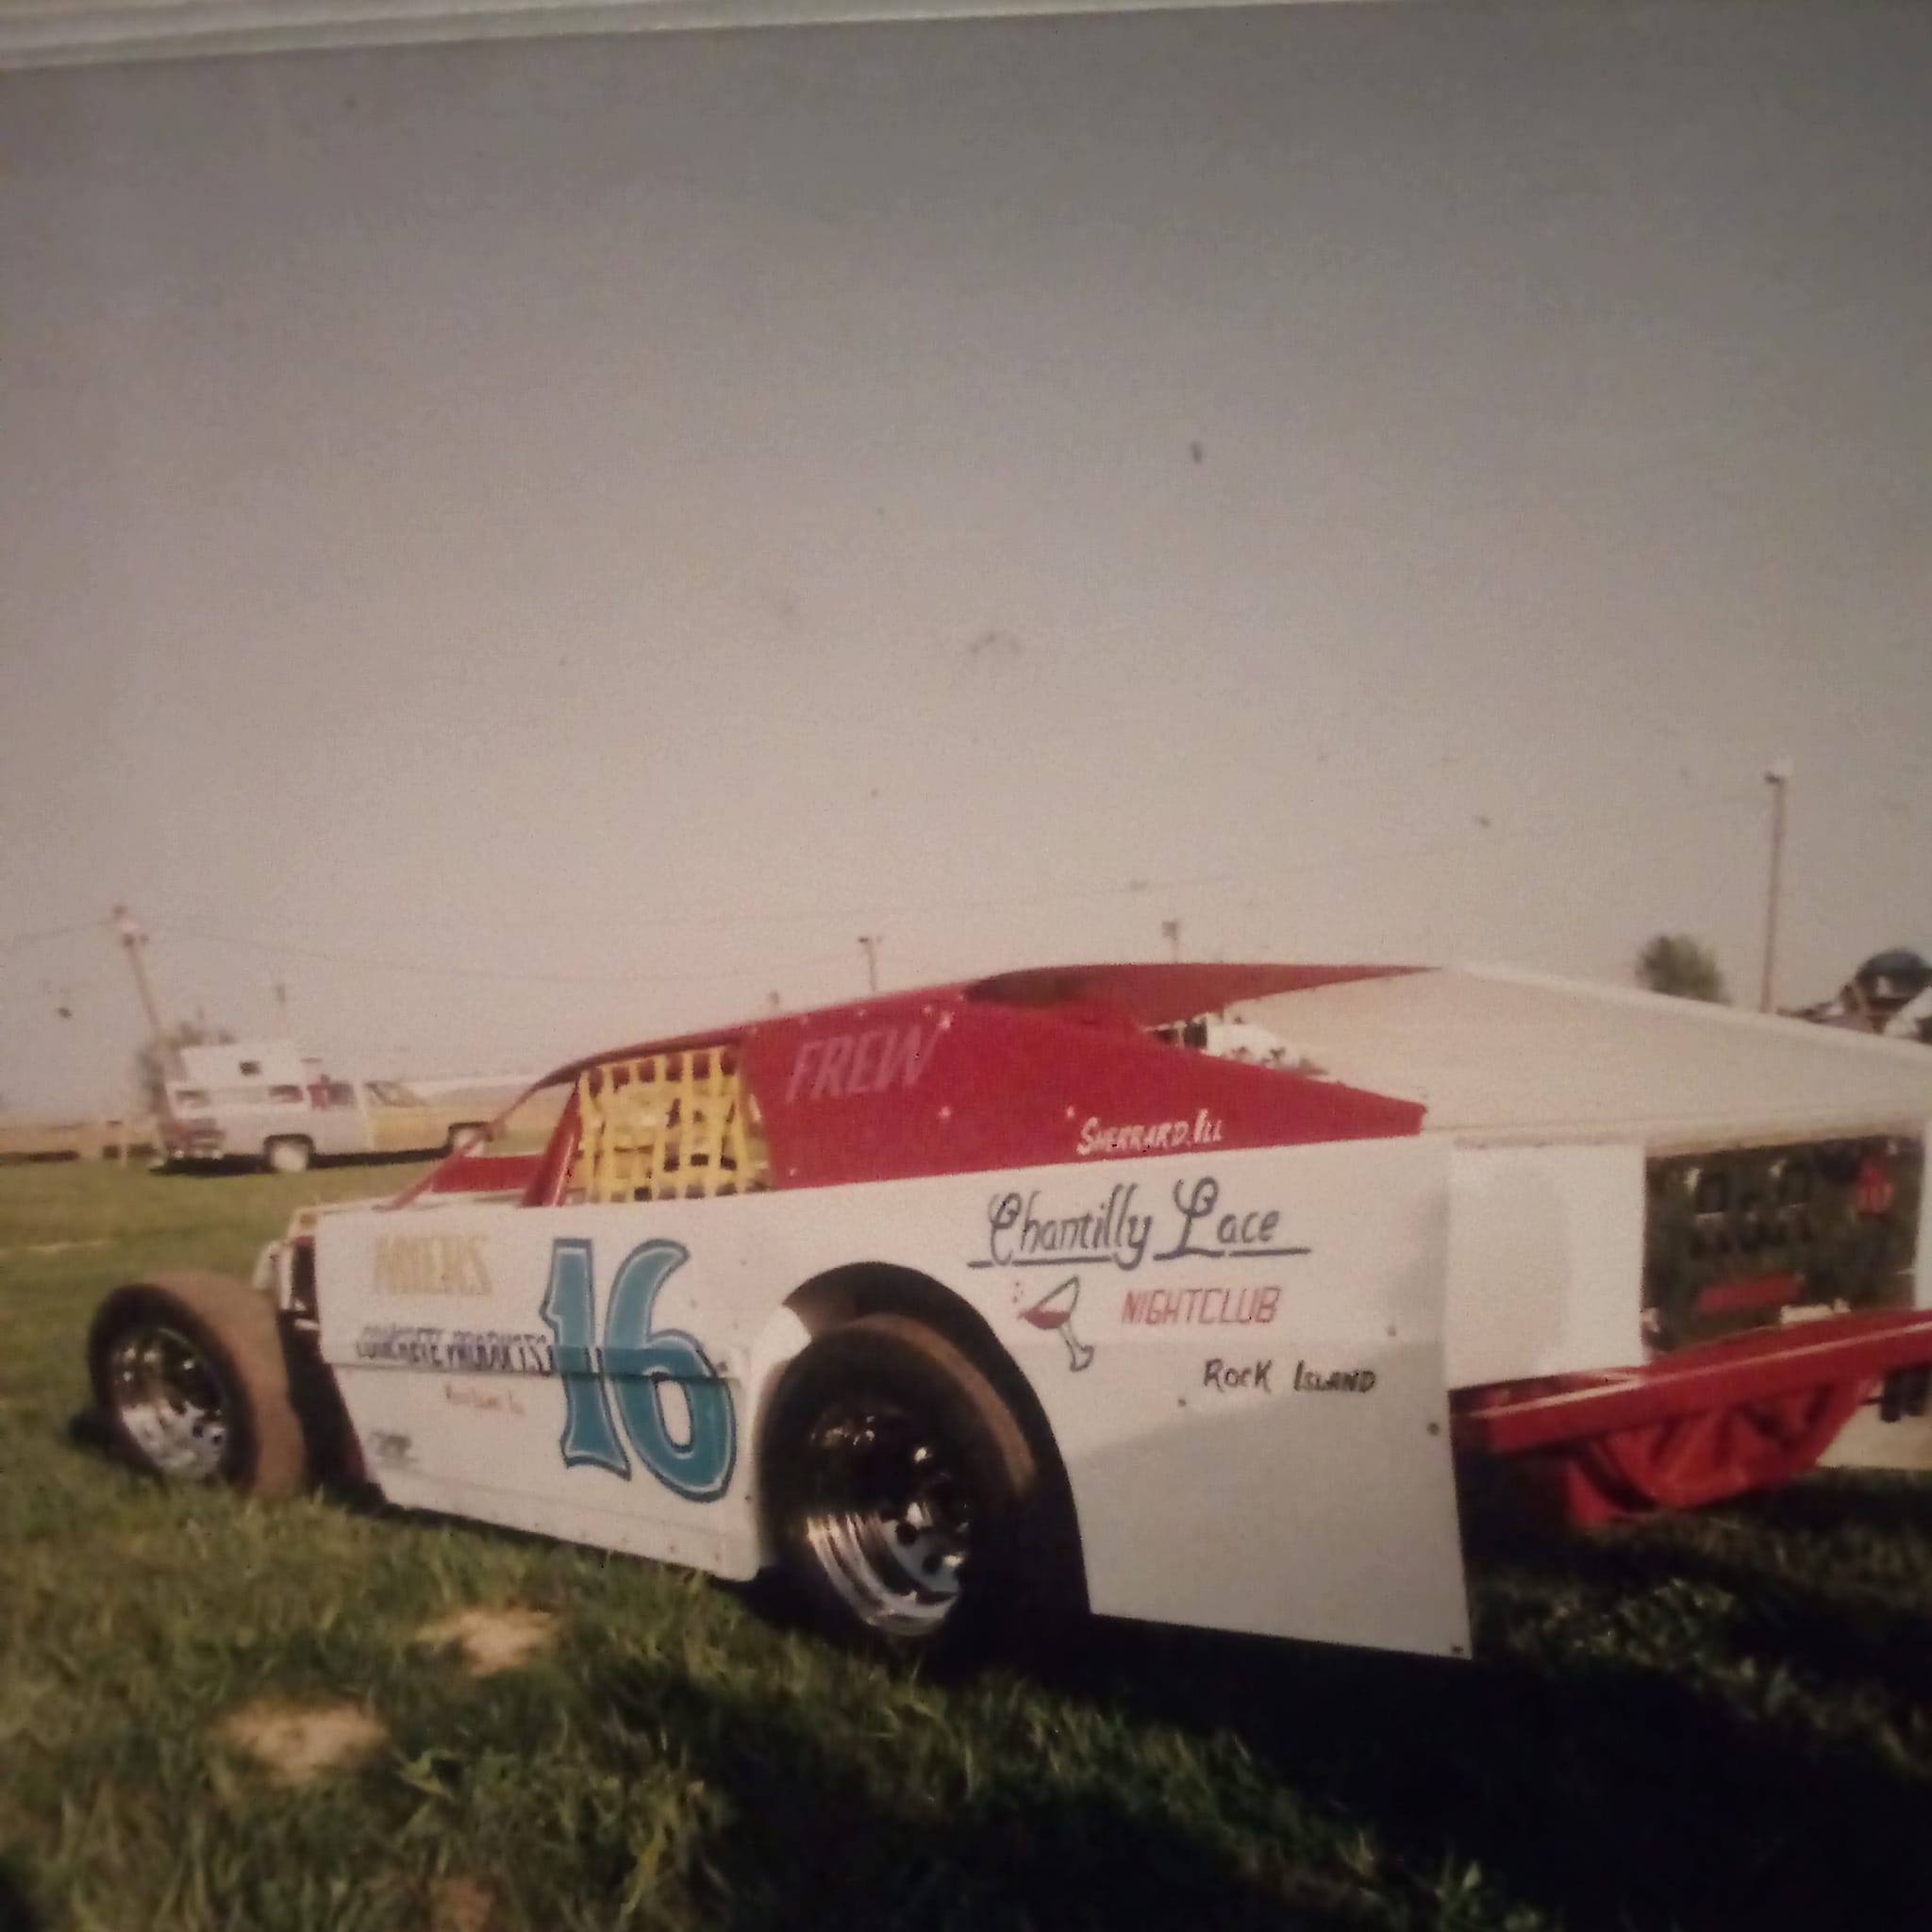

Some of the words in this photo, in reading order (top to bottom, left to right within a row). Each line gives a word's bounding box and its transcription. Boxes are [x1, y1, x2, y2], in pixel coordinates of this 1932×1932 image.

[786, 1024, 943, 1104] FREW
[989, 1182, 1152, 1271] Chantilly
[1153, 1176, 1281, 1260] Lace
[1122, 1284, 1282, 1324] NIGHTCLUB
[539, 1238, 737, 1504] 16
